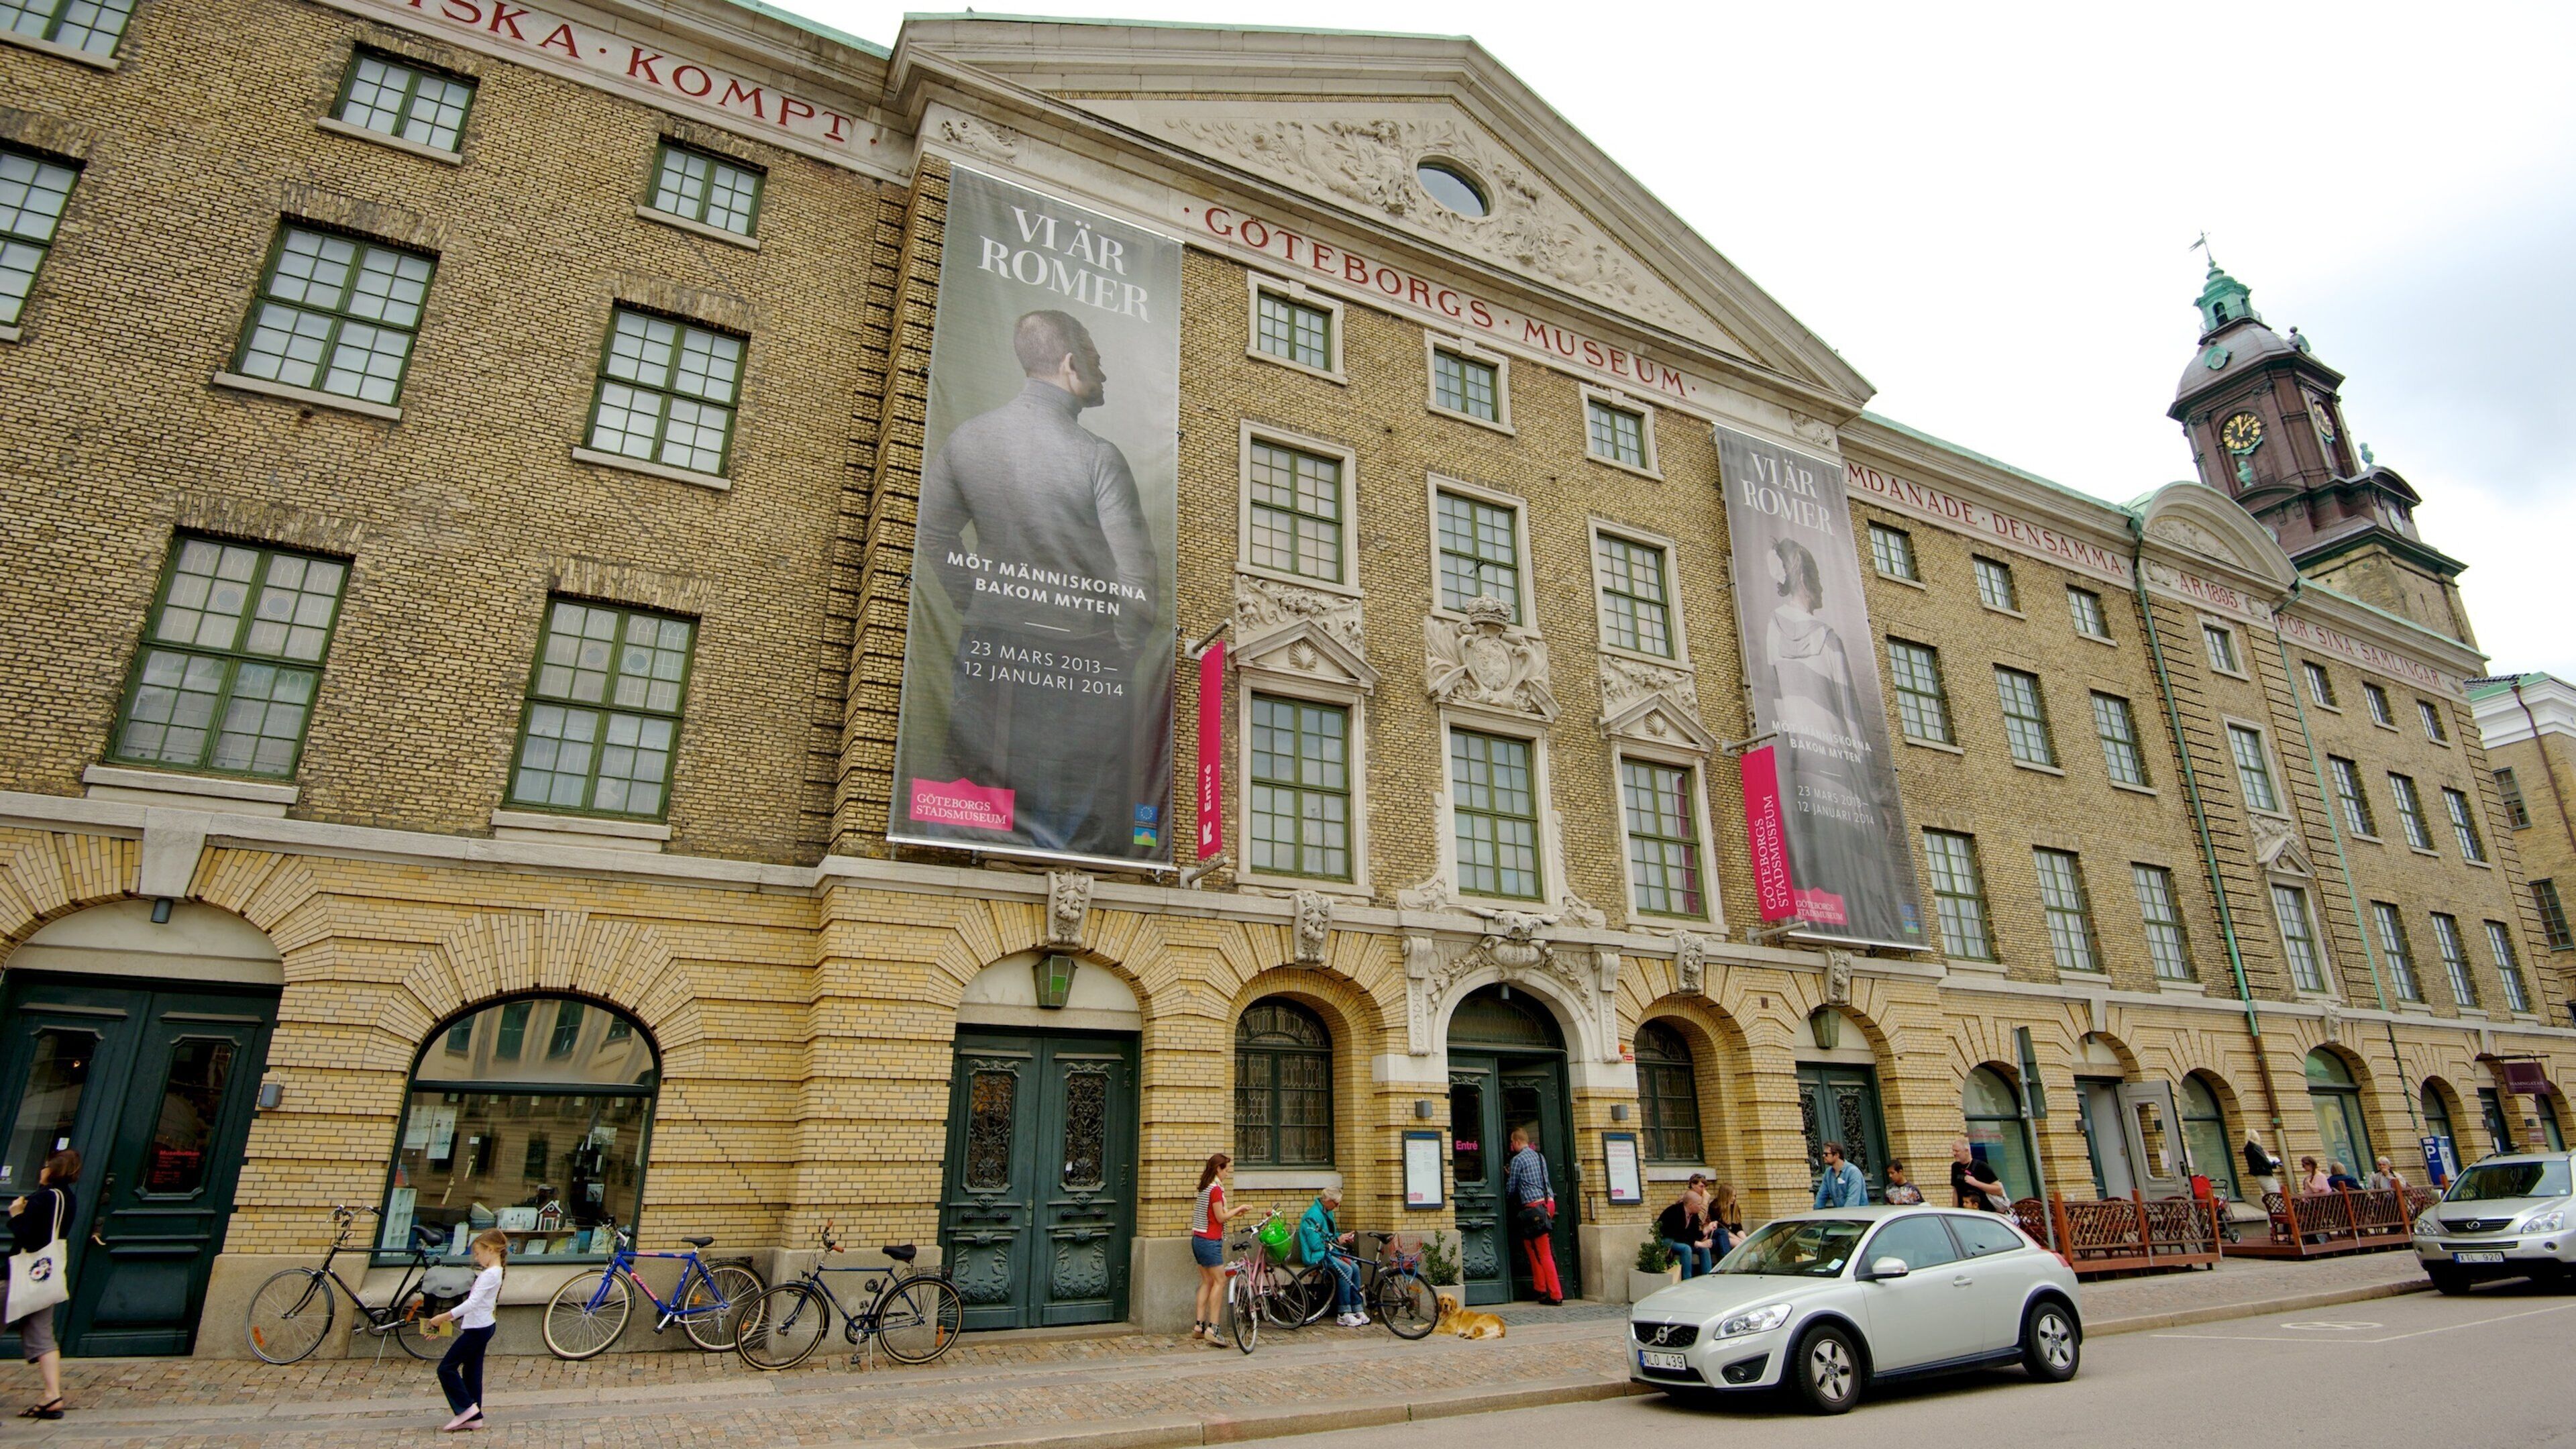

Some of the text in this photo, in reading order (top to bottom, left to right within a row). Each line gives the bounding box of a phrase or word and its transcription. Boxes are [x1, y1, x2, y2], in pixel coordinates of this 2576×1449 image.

[407, 0, 582, 59] SKA
[1010, 205, 1127, 276] VI ÄR
[977, 235, 1151, 323] ROMER
[1204, 207, 1688, 397] GÖTEBORGS MUSEUM
[1750, 451, 1818, 499] VI ÄR
[1740, 478, 1835, 536] ROMER
[1991, 512, 2124, 575] DENSAMMA
[947, 551, 1147, 602] MÖT MÄNNISKORNA
[2205, 582, 2238, 608] 1895
[975, 577, 1120, 616] BAKOM MYTEN
[970, 640, 991, 657] 23
[1000, 645, 1053, 667] MARS
[2315, 626, 2355, 655] SINA
[2360, 643, 2442, 688] SAMLINGAR
[964, 660, 1124, 697] 12 JANUARI 2014
[1771, 720, 1872, 752] MÖT MÄNNISKORNA
[1790, 738, 1862, 764] BAKOM MYTEN
[916, 793, 991, 812] GÖTEBORGS
[1797, 785, 1811, 797] 23
[1813, 788, 1839, 804] MARS
[1797, 800, 1875, 826] 12 JANUARI 2014
[916, 804, 1007, 824] STADSMUSEUM
[1754, 818, 1776, 910] GÖTEBORGS
[1762, 794, 1789, 908] STADSMUSEUM
[1455, 1140, 1478, 1150] Entré
[2424, 1145, 2436, 1159] P
[2459, 1253, 2502, 1262] XTL 920
[1666, 1355, 1683, 1368] 439
